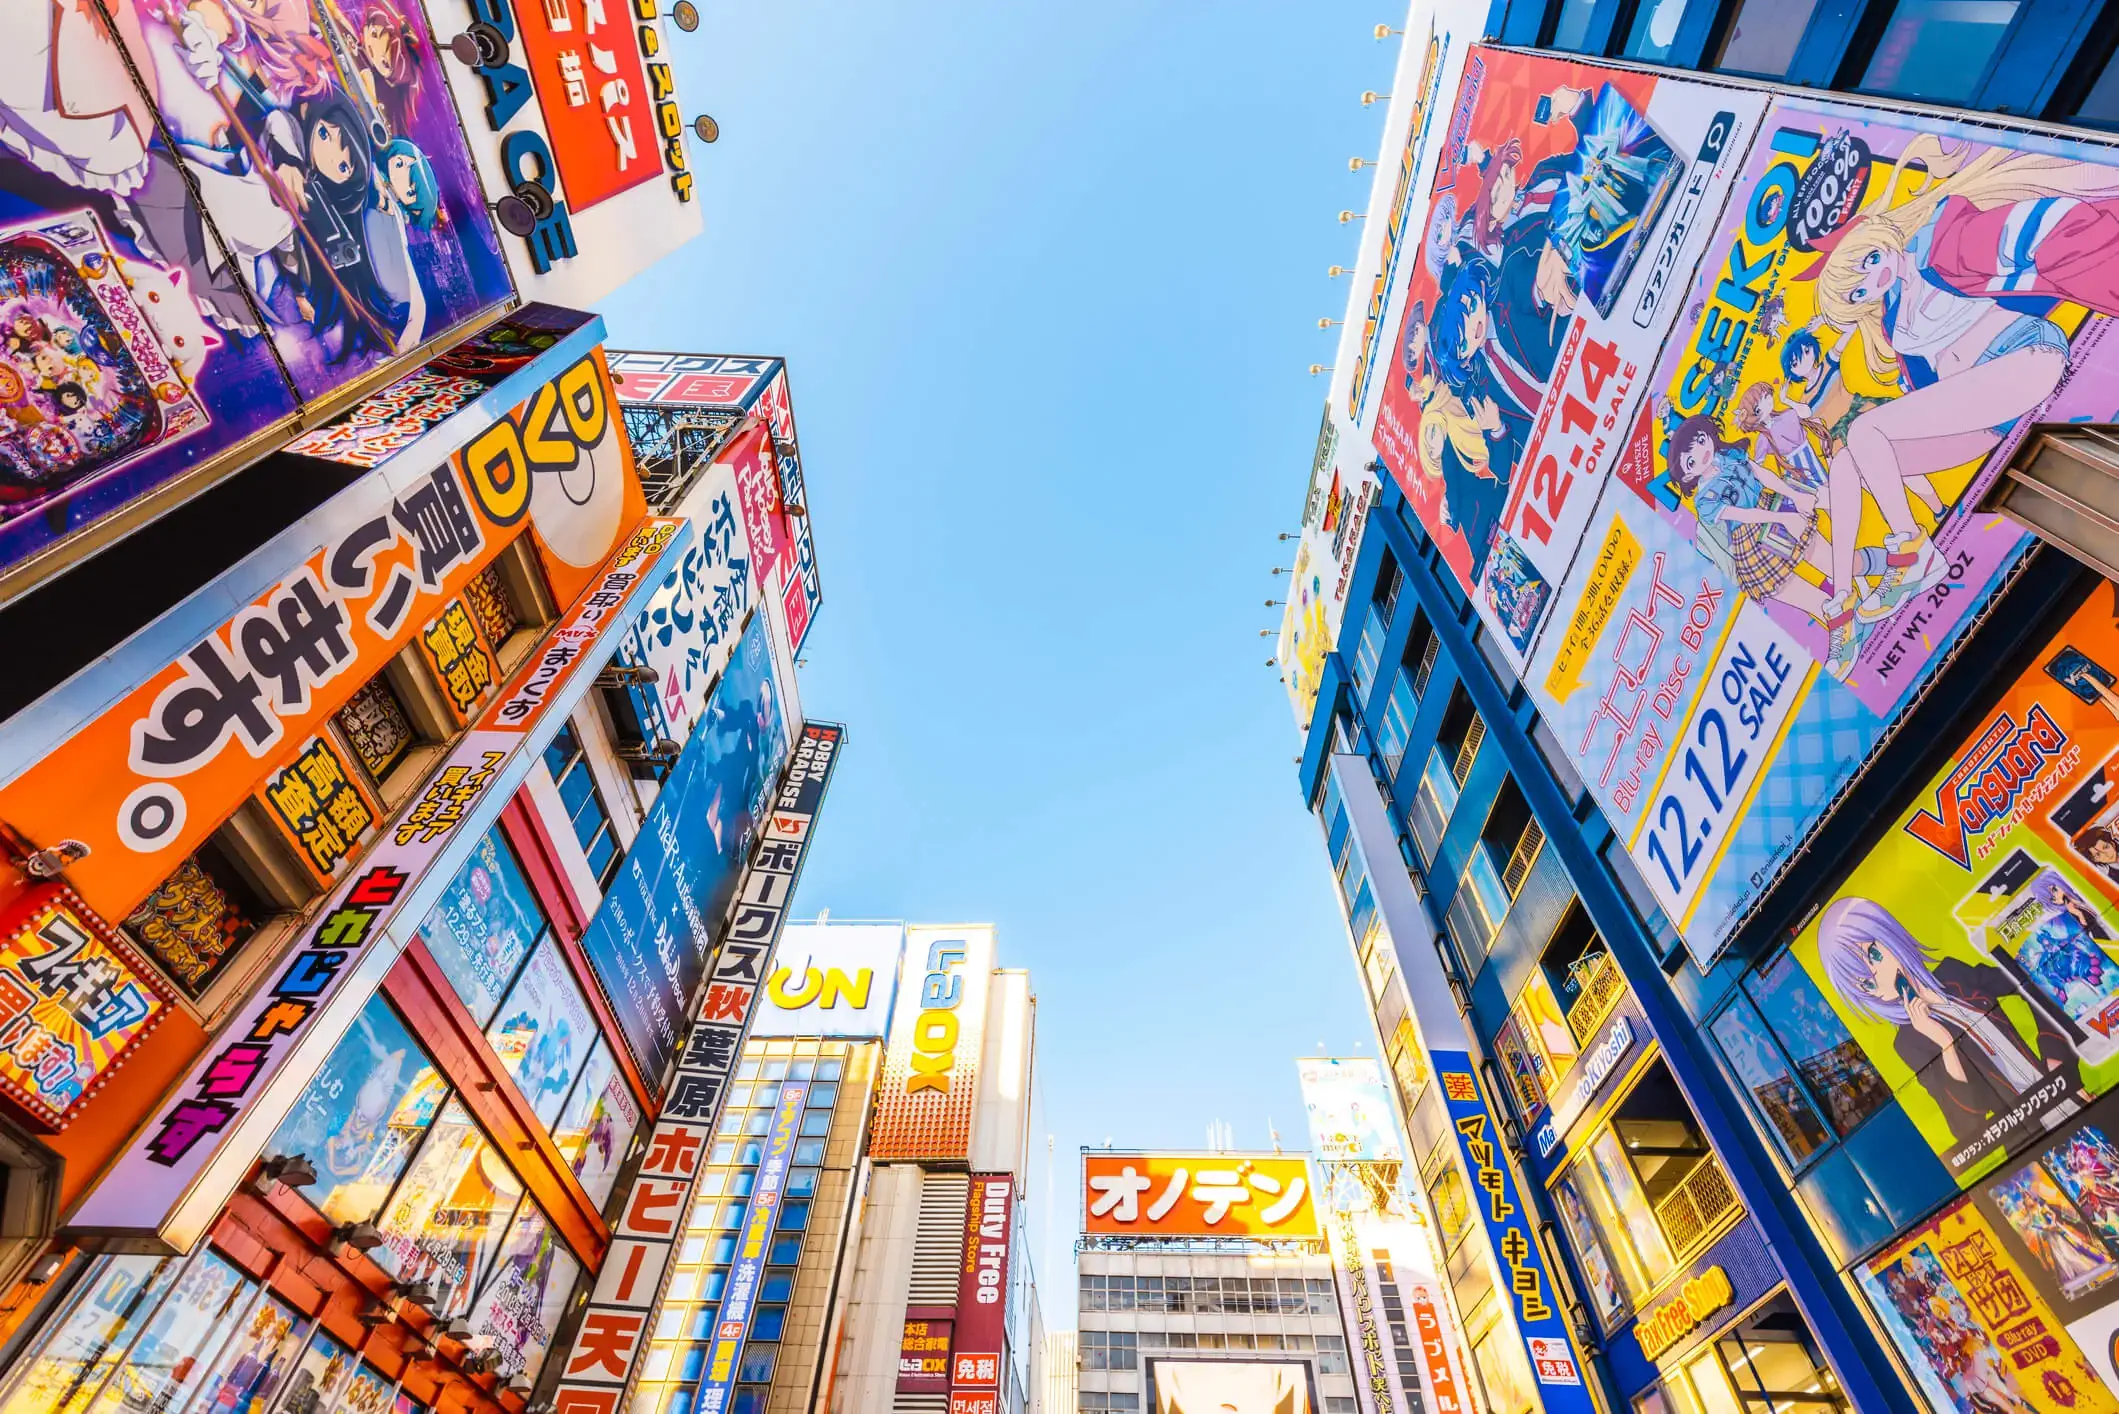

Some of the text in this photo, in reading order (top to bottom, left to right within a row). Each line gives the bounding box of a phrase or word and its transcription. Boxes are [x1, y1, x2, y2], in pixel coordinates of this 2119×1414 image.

[1642, 172, 1704, 312] ヴァンガード
[1533, 325, 1582, 444] ブースターパック
[1585, 360, 1638, 476] ON SALE
[461, 352, 608, 527] DVD
[1520, 336, 1624, 547] 12.14
[643, 524, 677, 555] DVD
[443, 599, 493, 691] 現金
[580, 572, 638, 622] 買取り
[1876, 550, 1975, 680] NET WT. 20 OZ
[422, 616, 476, 716] 買取
[1611, 576, 1725, 815] Blu-ray Disc BOX
[1720, 642, 1758, 707] ON
[1737, 641, 1792, 741] SALE
[293, 738, 377, 844] 高額
[416, 751, 506, 845] フィギュア
[777, 727, 820, 810] PARADISE
[810, 728, 839, 785] HOBBY
[1646, 707, 1748, 896] 12.12
[1903, 702, 2068, 874] Vanguard
[262, 768, 348, 876] 査定
[394, 765, 473, 848] 買います
[443, 905, 470, 947] 12.29
[15, 911, 151, 1042] フィギュア
[144, 865, 412, 1169] とれじゃらす
[1444, 1072, 1475, 1100] 薬
[966, 1181, 985, 1273] Flagship Store
[1088, 1160, 1306, 1225] オノデン
[1455, 1114, 1551, 1322] マツモト キヨシ
[976, 1181, 1010, 1305] Duty Free
[721, 1323, 742, 1337] 4F
[901, 1338, 949, 1352] 総合家電
[904, 1323, 929, 1337] 本店
[1635, 1264, 1734, 1362] Tax Free Shop
[2022, 1342, 2048, 1364] DVD
[957, 1358, 995, 1380] 免税
[1418, 1313, 1460, 1412] ラブメル
[1541, 1360, 1572, 1377] 免税
